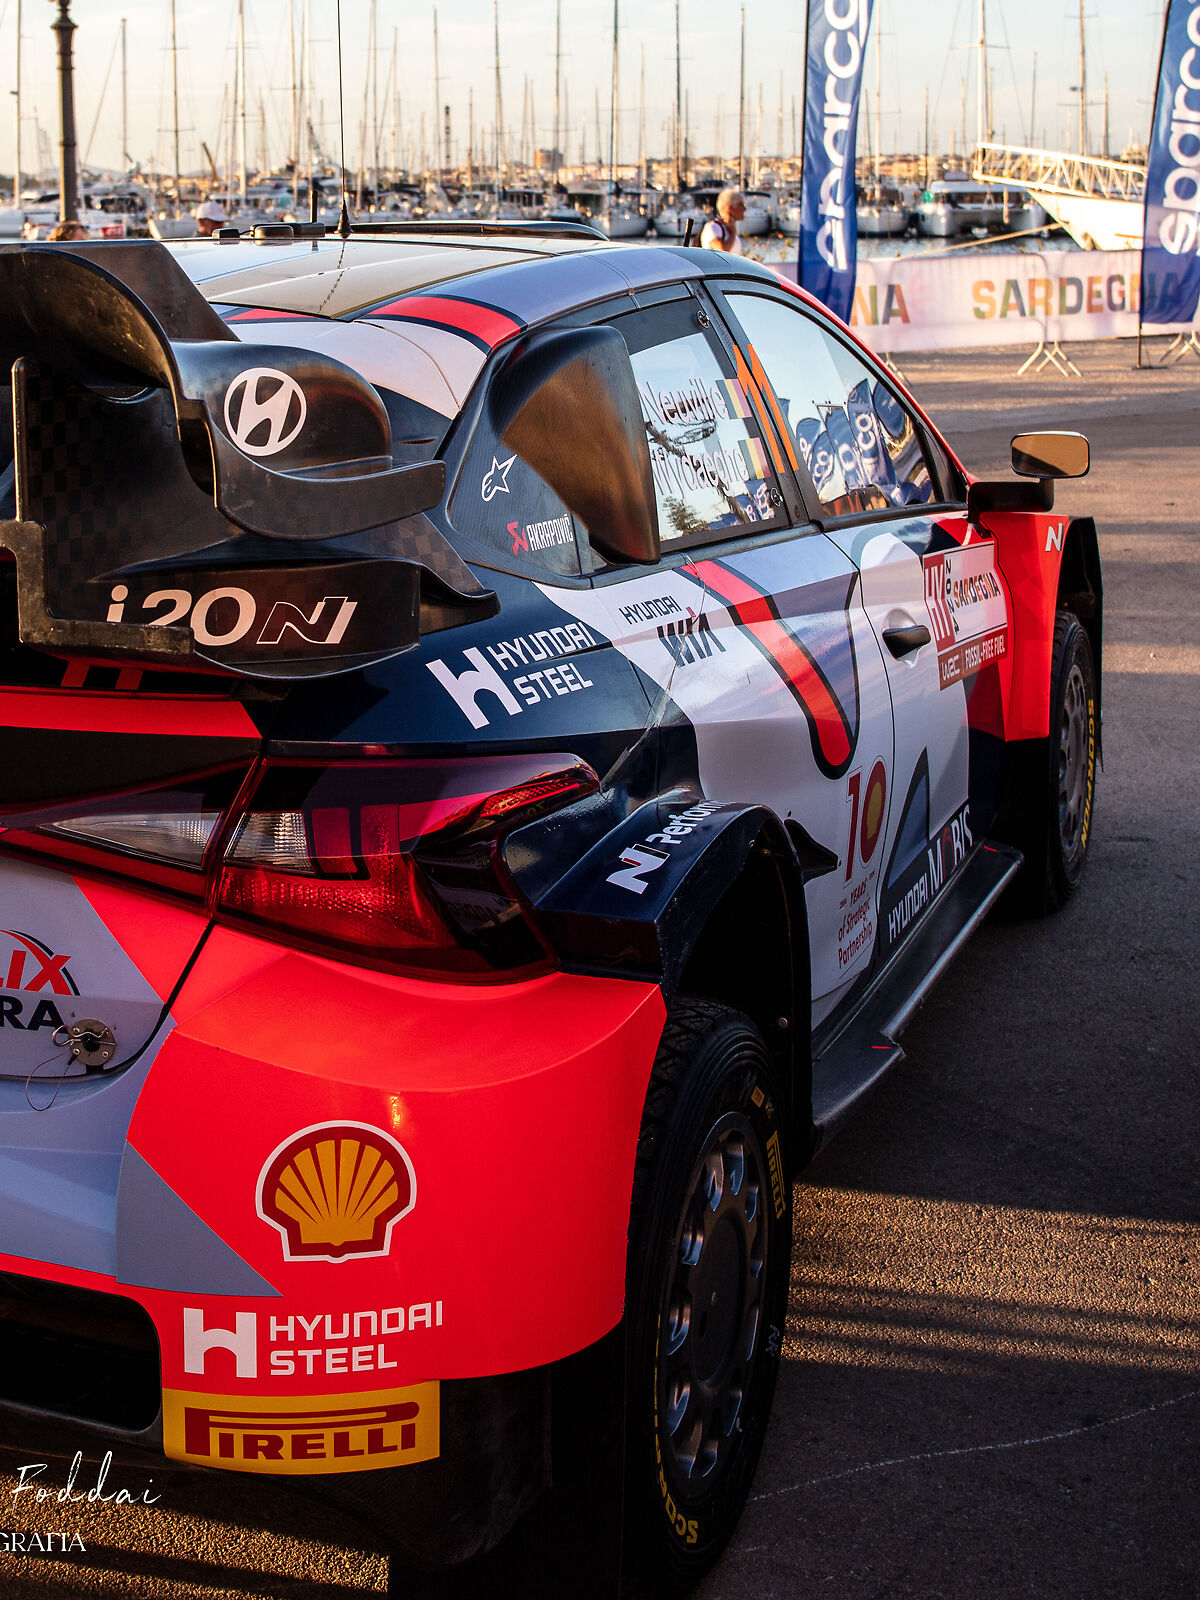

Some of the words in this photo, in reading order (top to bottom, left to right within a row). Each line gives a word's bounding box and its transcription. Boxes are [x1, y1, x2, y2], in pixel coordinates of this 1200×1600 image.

[638, 377, 730, 427] Neuville
[619, 595, 683, 625] HYUNDAI
[953, 572, 1001, 609] SARDEGNA
[486, 621, 596, 672] HYUNDAI
[512, 662, 594, 706] STEEL
[888, 872, 929, 944] HYUNDAI
[928, 804, 973, 896] MOBIS
[838, 921, 873, 970] Partnership
[766, 1130, 786, 1220] PIRELLI
[269, 1300, 443, 1342] HYUNDAI
[269, 1343, 398, 1376] STEEL
[184, 1401, 420, 1460] PIRELLI
